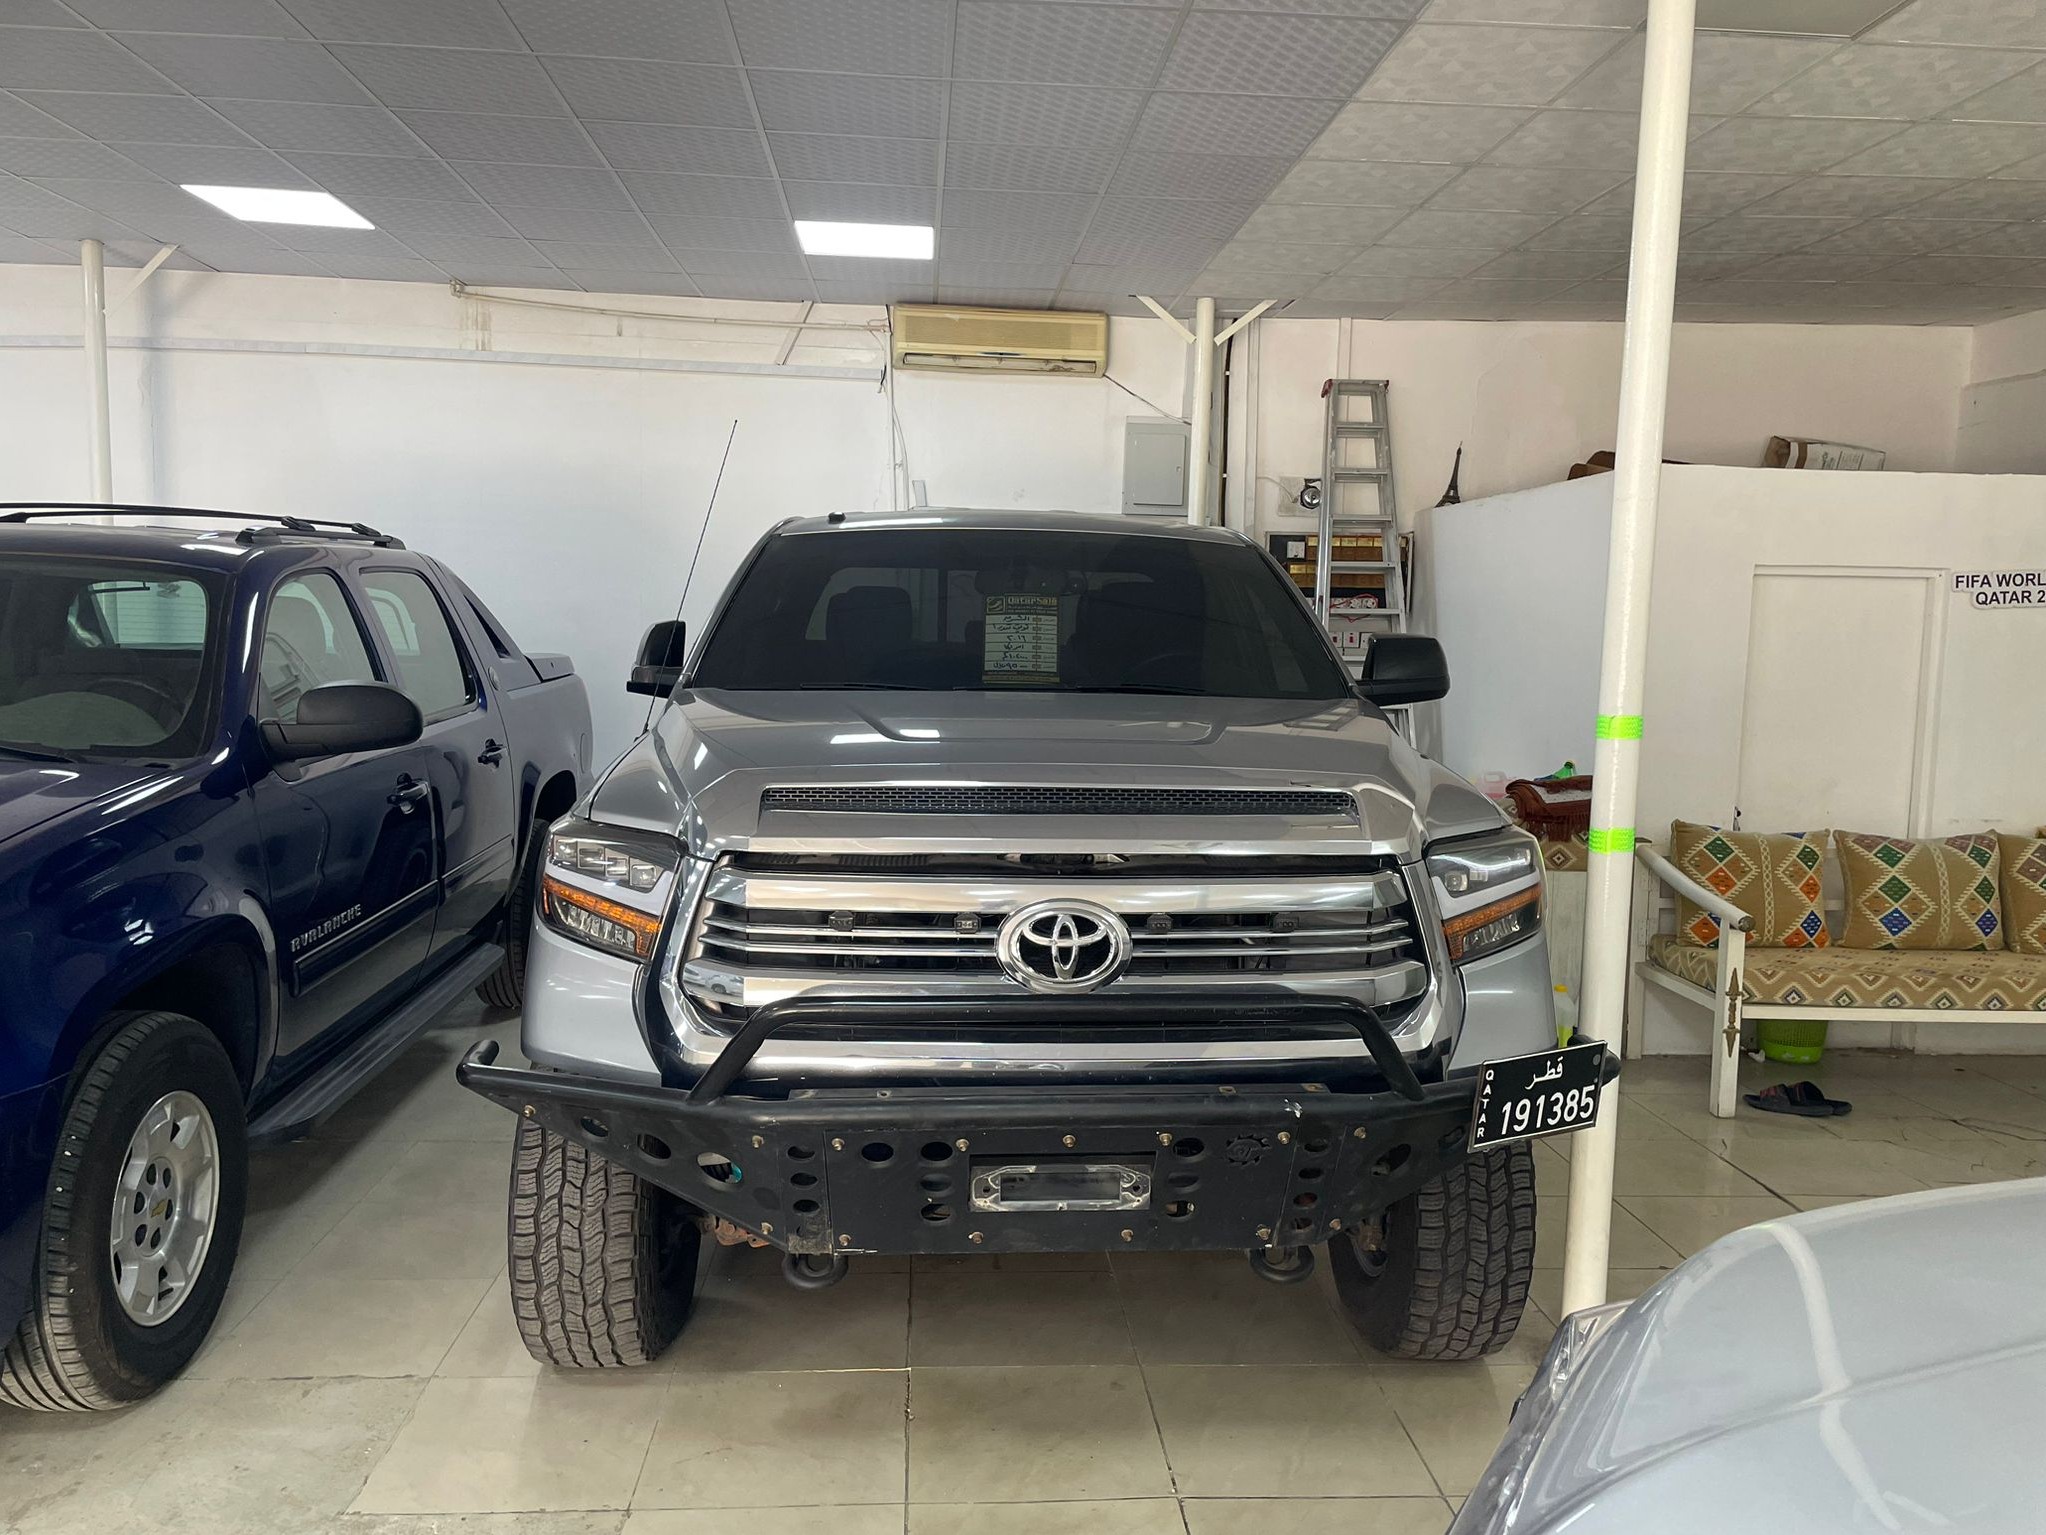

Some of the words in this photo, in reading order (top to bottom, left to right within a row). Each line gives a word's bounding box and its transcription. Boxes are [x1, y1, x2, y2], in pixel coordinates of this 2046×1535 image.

[1955, 574, 1992, 589] FIFA
[1996, 573, 2046, 587] WORL
[1975, 590, 2032, 606] QATAR
[290, 903, 361, 952] AVALANCHE
[1524, 1056, 1564, 1090] قطر
[1477, 1070, 1495, 1138] QATAR
[1501, 1084, 1595, 1135] 191385
